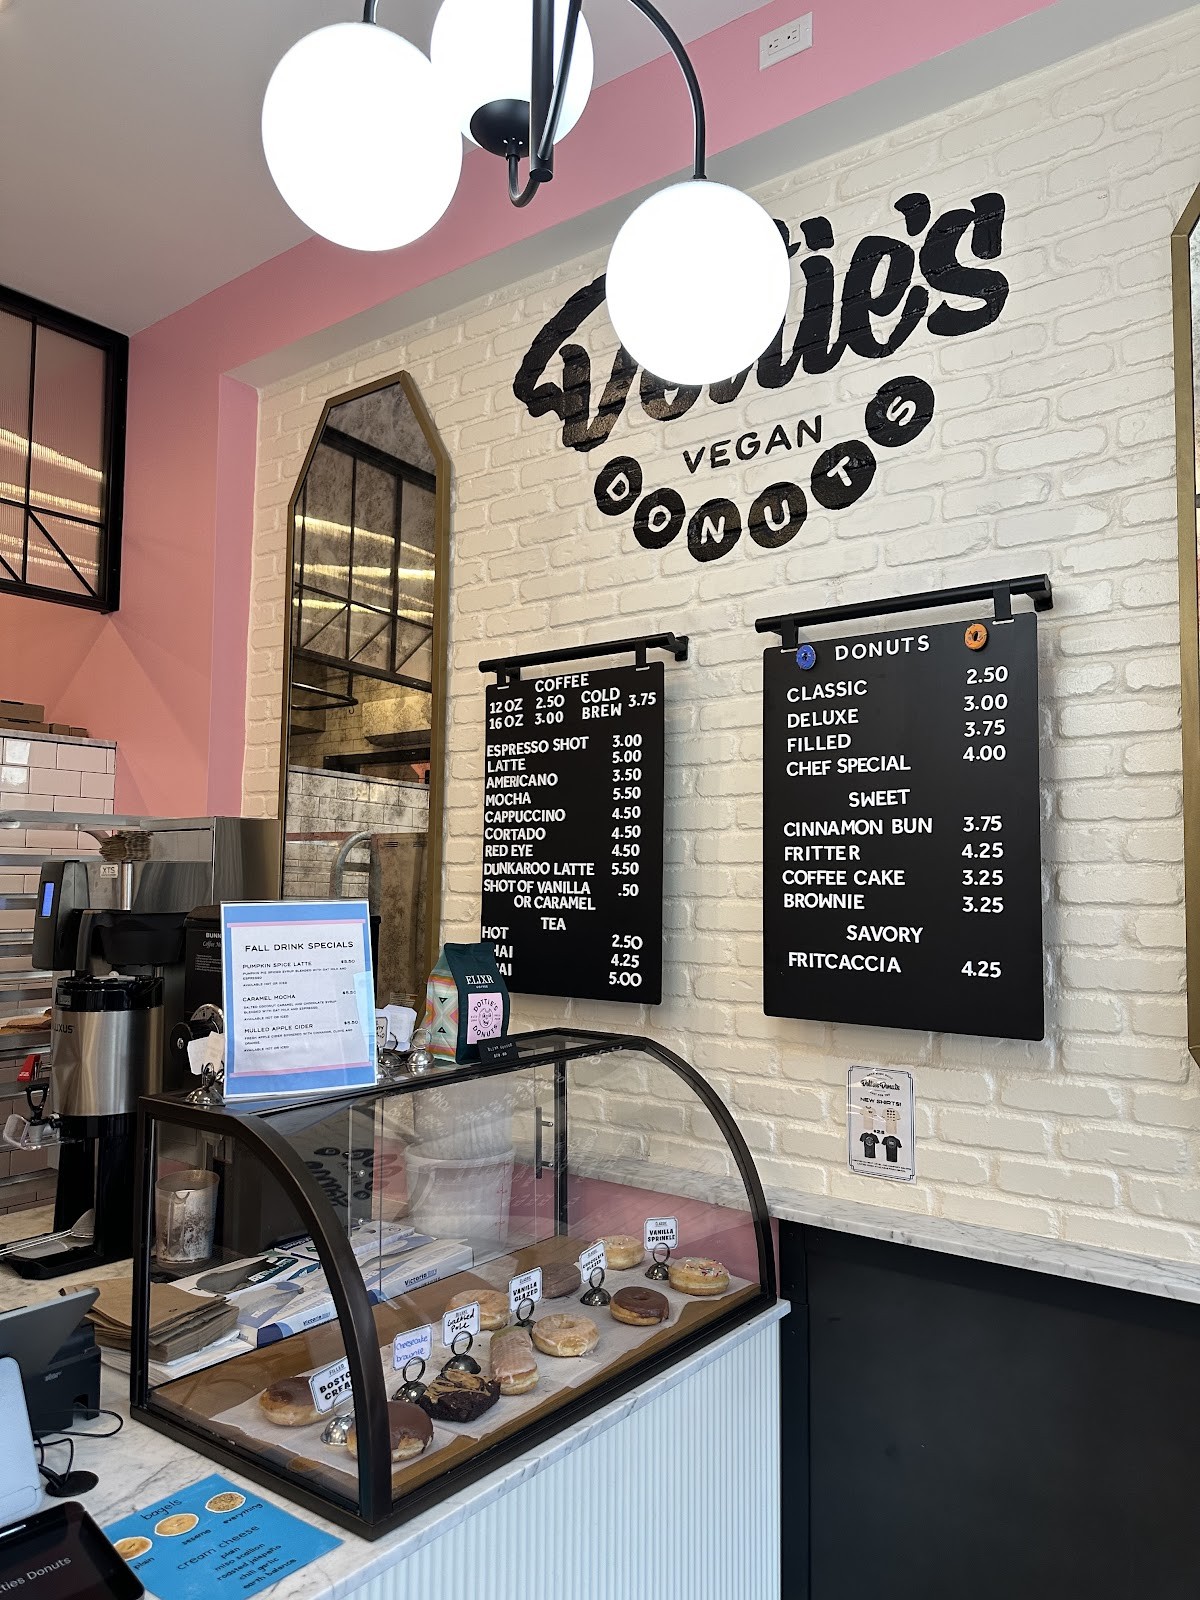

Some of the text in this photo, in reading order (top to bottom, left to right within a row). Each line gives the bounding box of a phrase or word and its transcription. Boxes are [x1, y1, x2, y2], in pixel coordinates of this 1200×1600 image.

[513, 192, 1009, 452] Die's
[683, 415, 823, 473] VEGAN
[602, 388, 921, 549] DONUTS
[835, 635, 929, 661] DONUTS
[535, 673, 589, 692] COFFEE
[787, 666, 1008, 702] CLASSIC 2.50
[581, 687, 620, 703] COLD
[629, 692, 656, 707] 3.75
[490, 695, 564, 714] 12 OZ 2.50
[582, 703, 621, 719] BREW
[788, 694, 1007, 728] DELUXE 3.00
[489, 711, 563, 729] 16 OZ 3.00
[788, 719, 1005, 752] FILLED 3.75
[487, 734, 642, 757] ESPRESSO SHOT 3.00
[488, 750, 641, 773] LATTE 5.00
[787, 745, 1006, 776] CHEF SPECIAL 4.00
[486, 768, 641, 789] AMERICANO 3.50
[486, 787, 641, 806] MOCHA 5.50
[849, 789, 910, 807] SWEET
[485, 806, 641, 823] CAPPUCCINO 4.50
[485, 825, 641, 840] CORTADO 4.50
[784, 816, 1002, 836] CINNAMON BUN 3.75
[485, 844, 640, 857] RED EYE 4.50
[785, 843, 1003, 861] FRITTER 4.25
[484, 862, 639, 875] DUNKAROO LATTE 5.50
[782, 870, 1003, 885] COFFEE CAKE 3.25
[484, 879, 639, 896] SHOT OF VANILLA .50
[514, 895, 596, 910] OR CARAMEL
[784, 893, 1003, 913] BROWNIE 3.25
[541, 917, 566, 930] TEA
[482, 926, 643, 950] HOT 2.50
[846, 925, 923, 943] SAVORY
[245, 941, 354, 953] FALL DRINK SPECIALS
[494, 945, 639, 968] HAI 4.25
[789, 952, 1001, 978] FRITCACCIA 4.25
[465, 974, 494, 985] ELIXR
[496, 963, 642, 986] AI 5.00
[54, 1024, 74, 1034] UXUS
[473, 1024, 498, 1038] DONUTS
[647, 1235, 675, 1243] SPRINKLE
[404, 1273, 427, 1286] Victoria
[513, 1281, 537, 1296] VANILLA
[514, 1288, 538, 1302] GLAZED
[396, 1335, 428, 1350] Cheesecake
[396, 1347, 426, 1362] brownie
[329, 1363, 345, 1375] FILLED
[319, 1371, 350, 1394] BOSTO
[324, 1381, 351, 1400] CREA
[140, 1499, 182, 1520] bagels
[222, 1502, 264, 1524] everything
[182, 1529, 212, 1545] sesame
[177, 1525, 260, 1570] cream cheese
[220, 1547, 241, 1560] plain
[133, 1557, 155, 1570] plain
[214, 1543, 265, 1572] miso scallion
[258, 1557, 280, 1573] garlic
[0, 1556, 72, 1594] ties Donuts
[216, 1562, 249, 1581] roasted
[243, 1559, 297, 1589] earth balance
